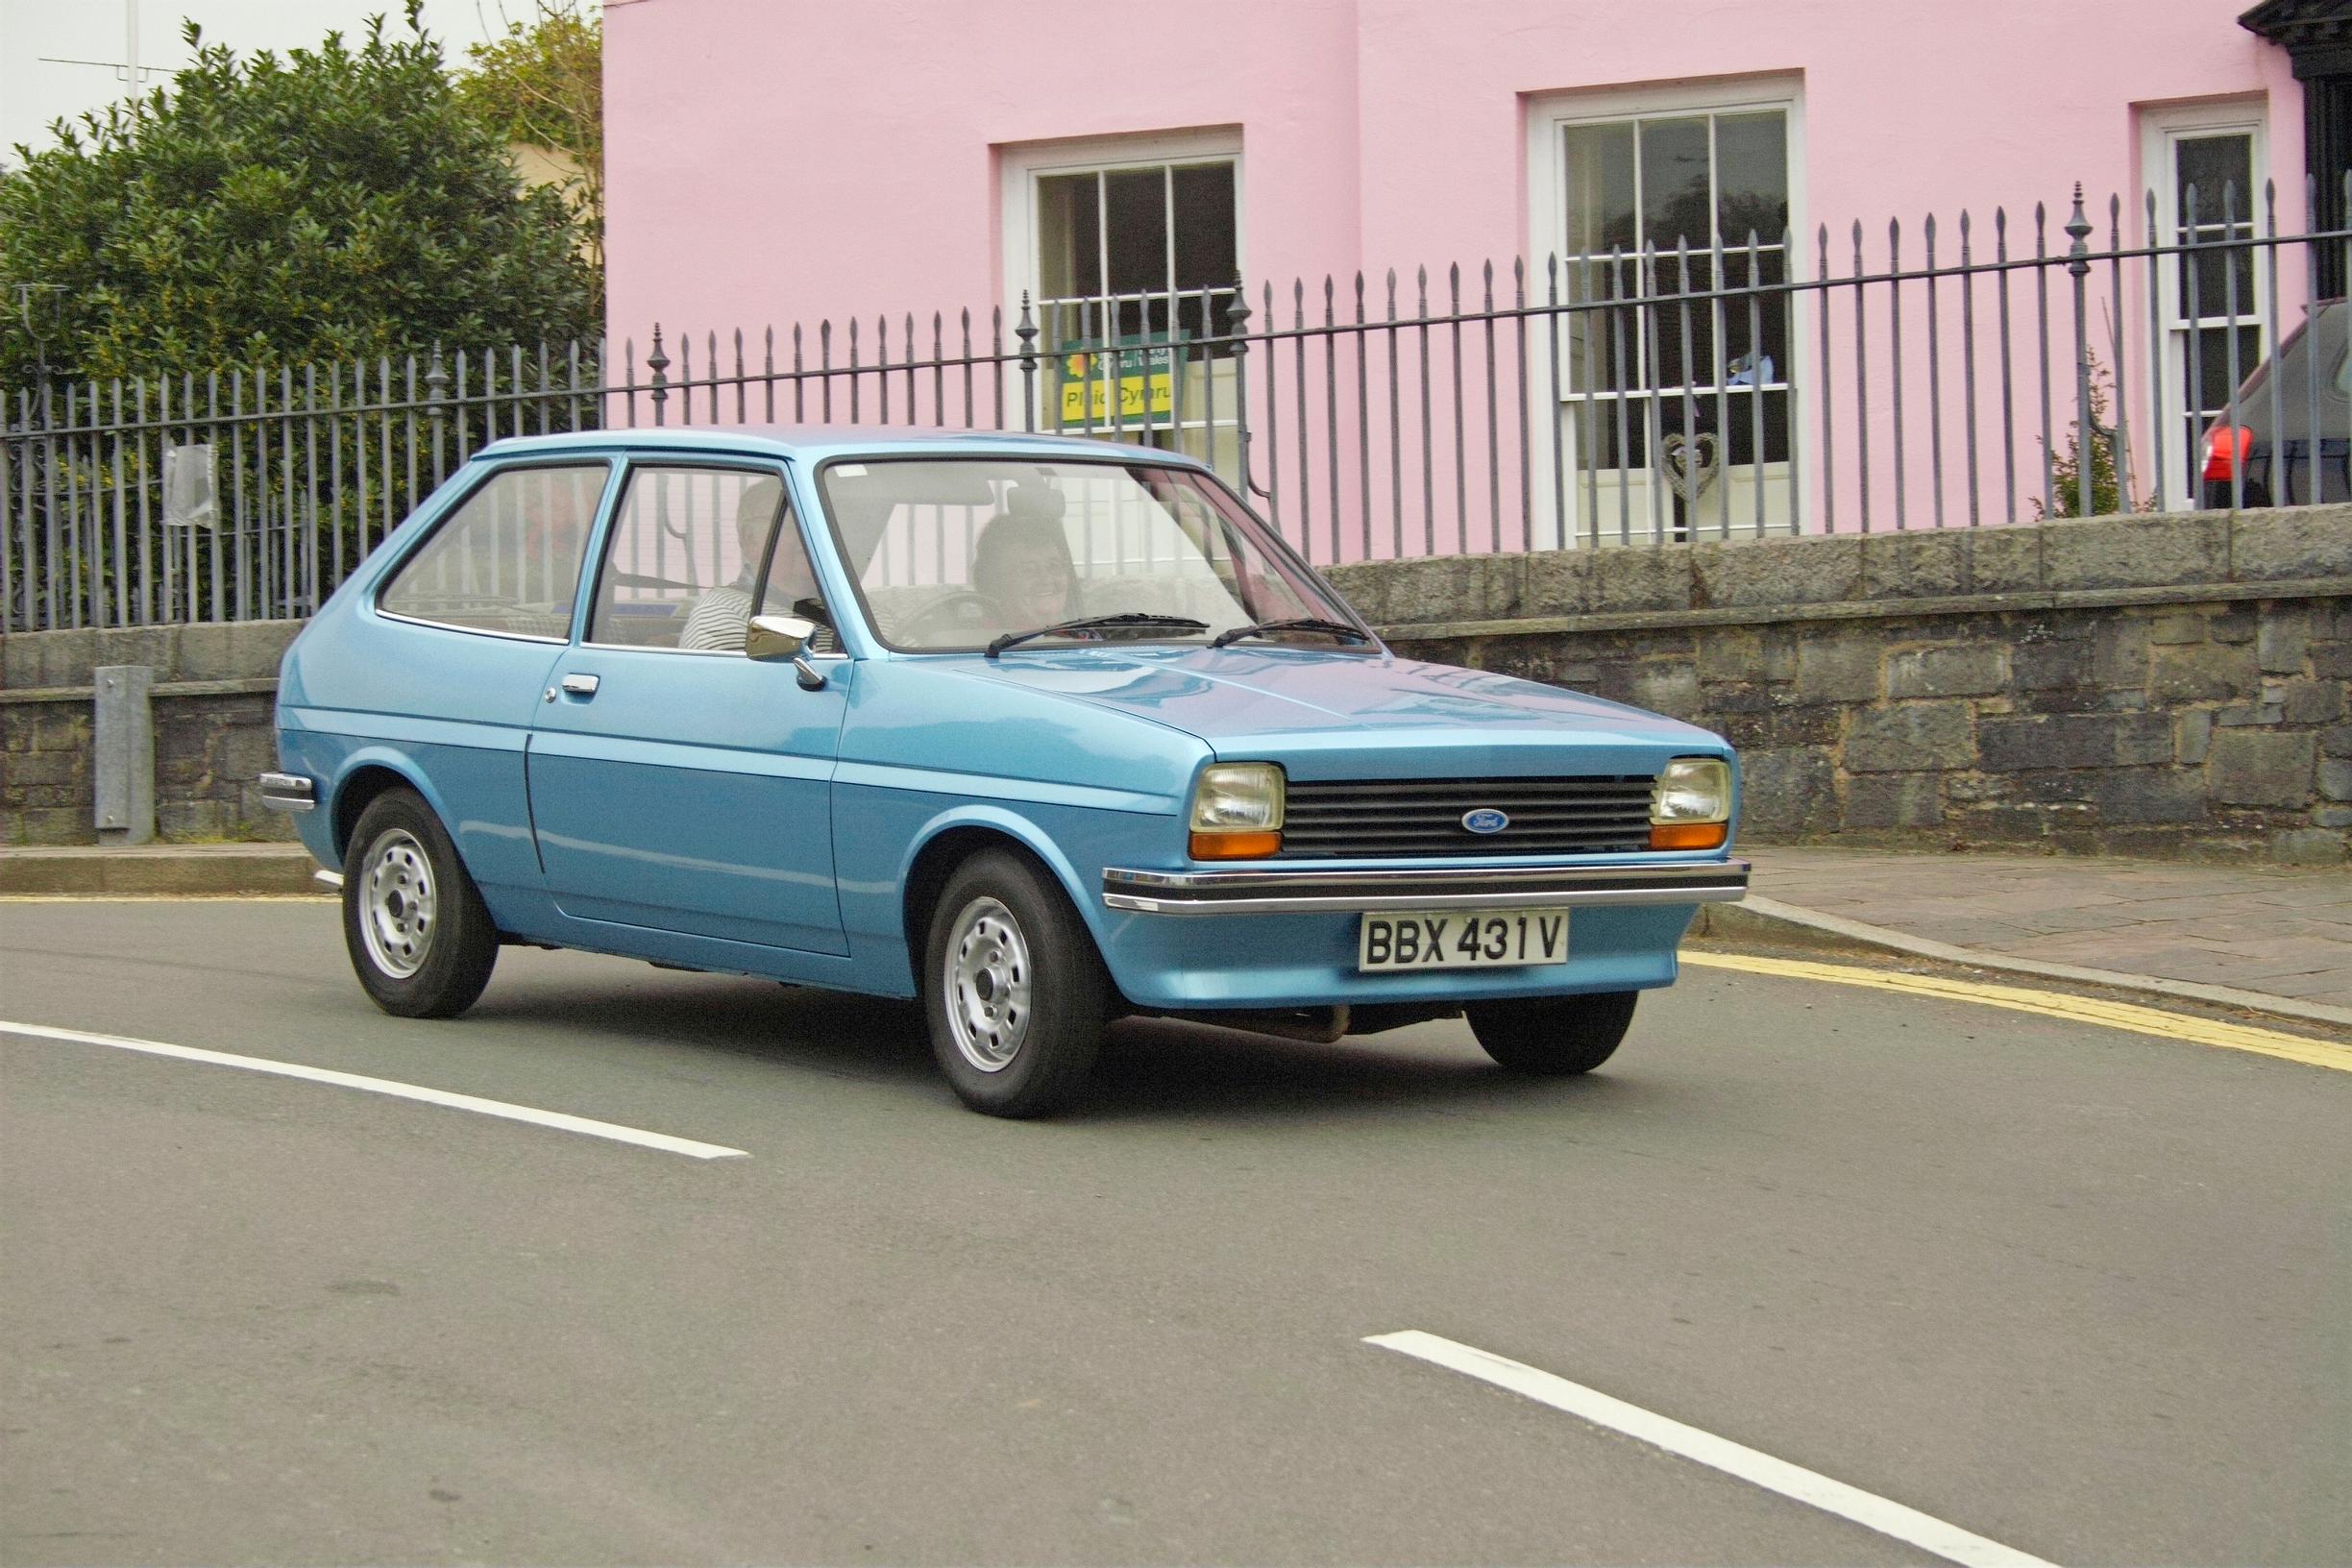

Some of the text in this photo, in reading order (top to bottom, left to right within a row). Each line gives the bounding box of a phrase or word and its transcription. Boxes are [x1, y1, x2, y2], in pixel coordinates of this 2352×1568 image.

[1066, 387, 1109, 408] Pli
[1366, 916, 1562, 965] BBX 431V
